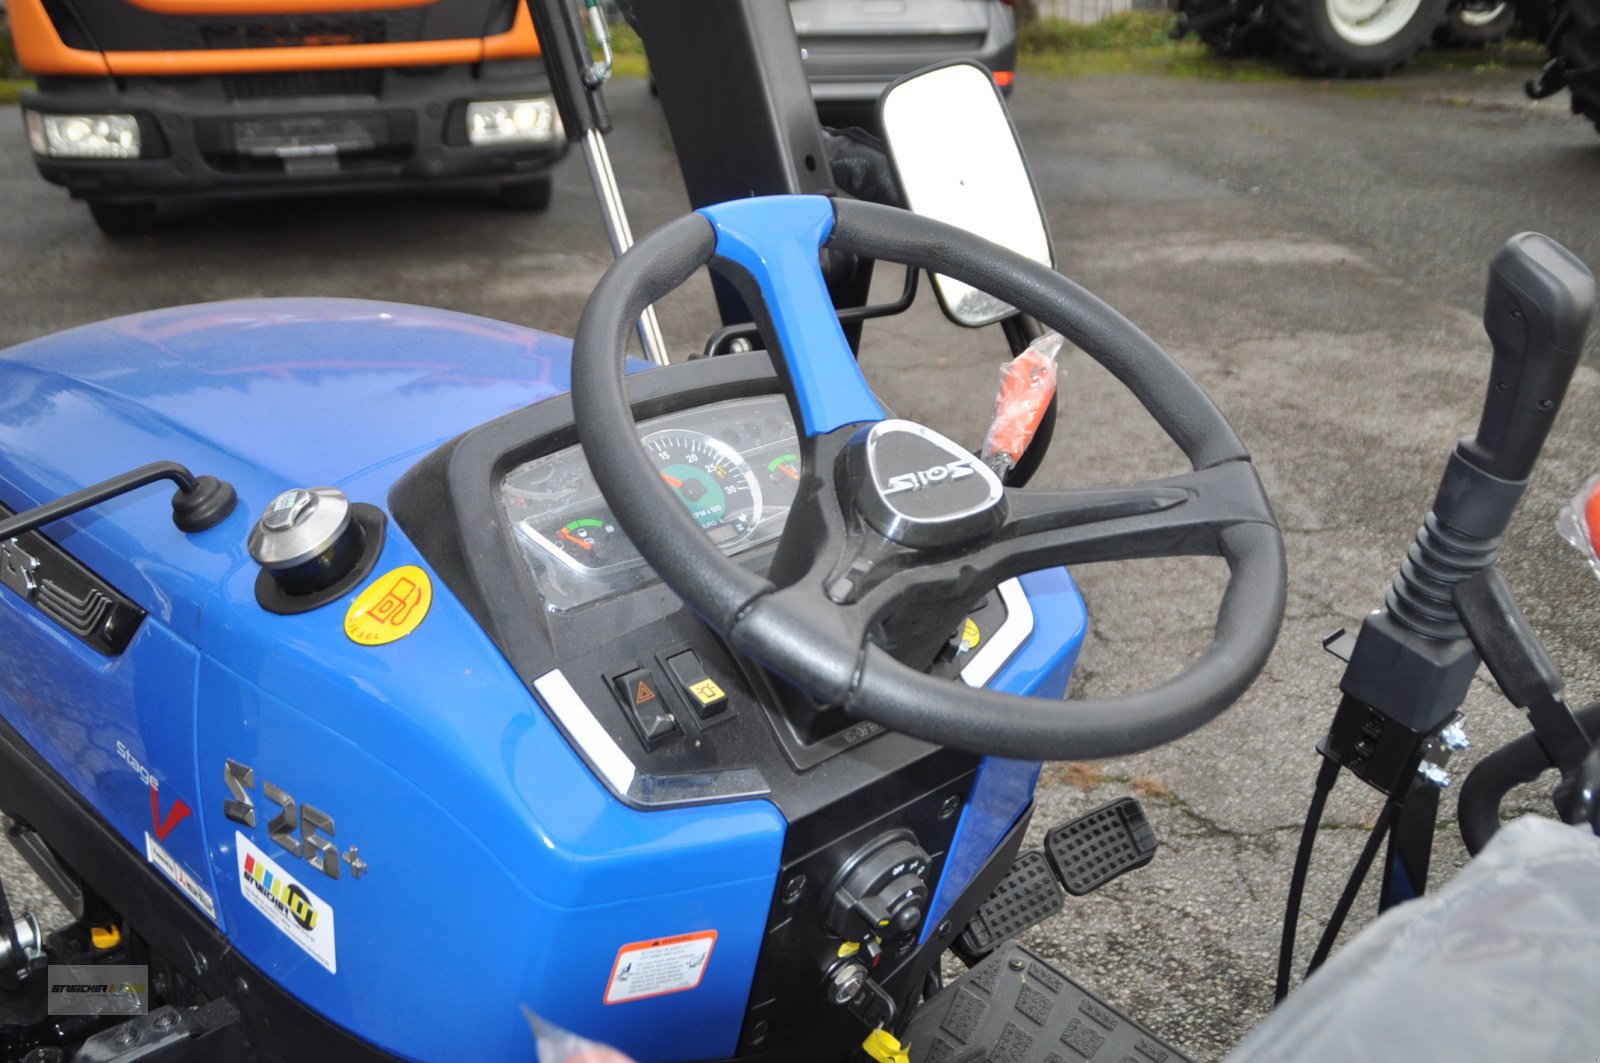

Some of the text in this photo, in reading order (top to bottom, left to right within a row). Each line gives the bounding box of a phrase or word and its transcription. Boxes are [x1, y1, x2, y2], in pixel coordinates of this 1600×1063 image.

[658, 452, 670, 461] 15
[686, 454, 698, 463] 20
[704, 464, 717, 473] 25
[725, 485, 737, 495] 30
[349, 617, 380, 640] DIESEL
[116, 740, 159, 792] Stage
